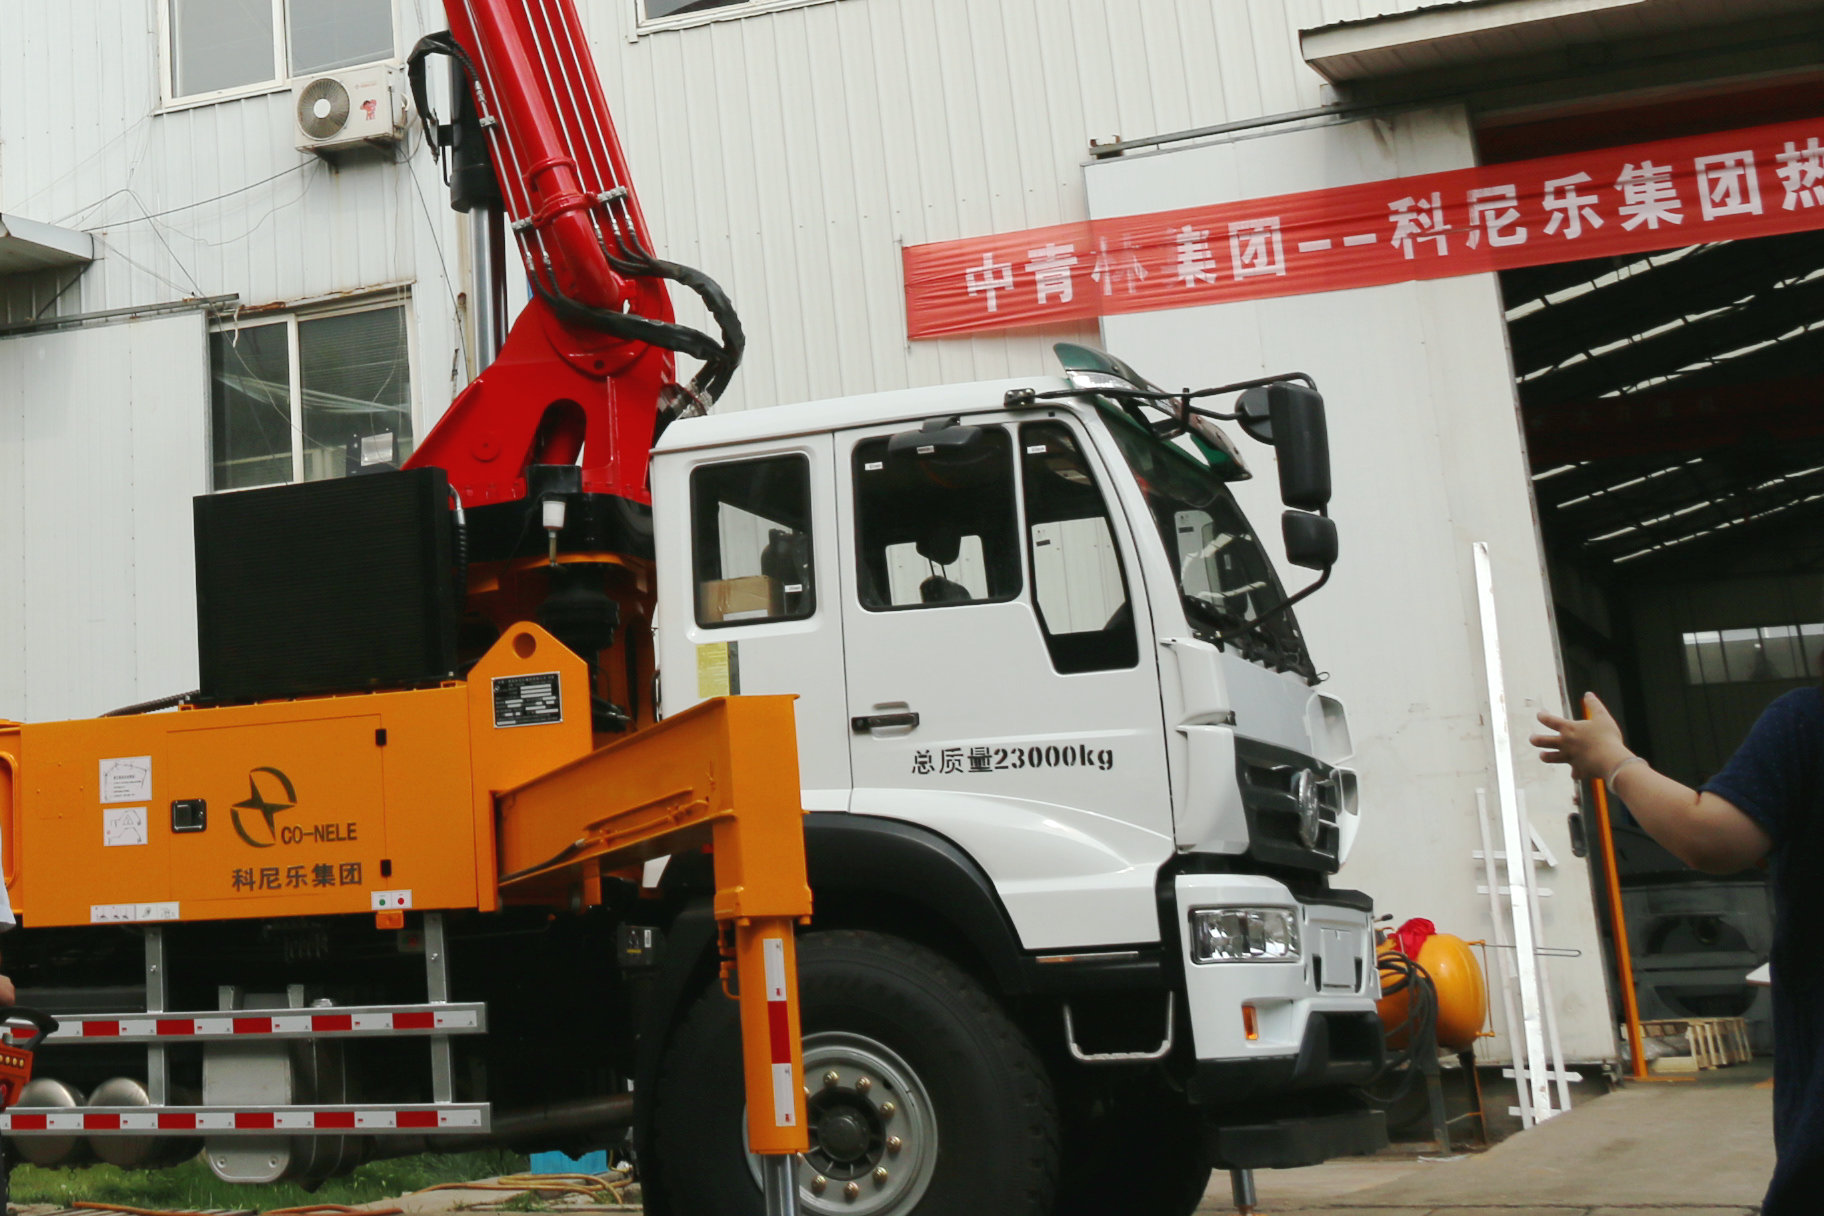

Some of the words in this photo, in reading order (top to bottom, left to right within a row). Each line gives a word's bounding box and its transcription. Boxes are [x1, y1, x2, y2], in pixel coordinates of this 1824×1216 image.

[281, 823, 358, 845] CO-NELE
[231, 861, 364, 892] 科尼乐集团
